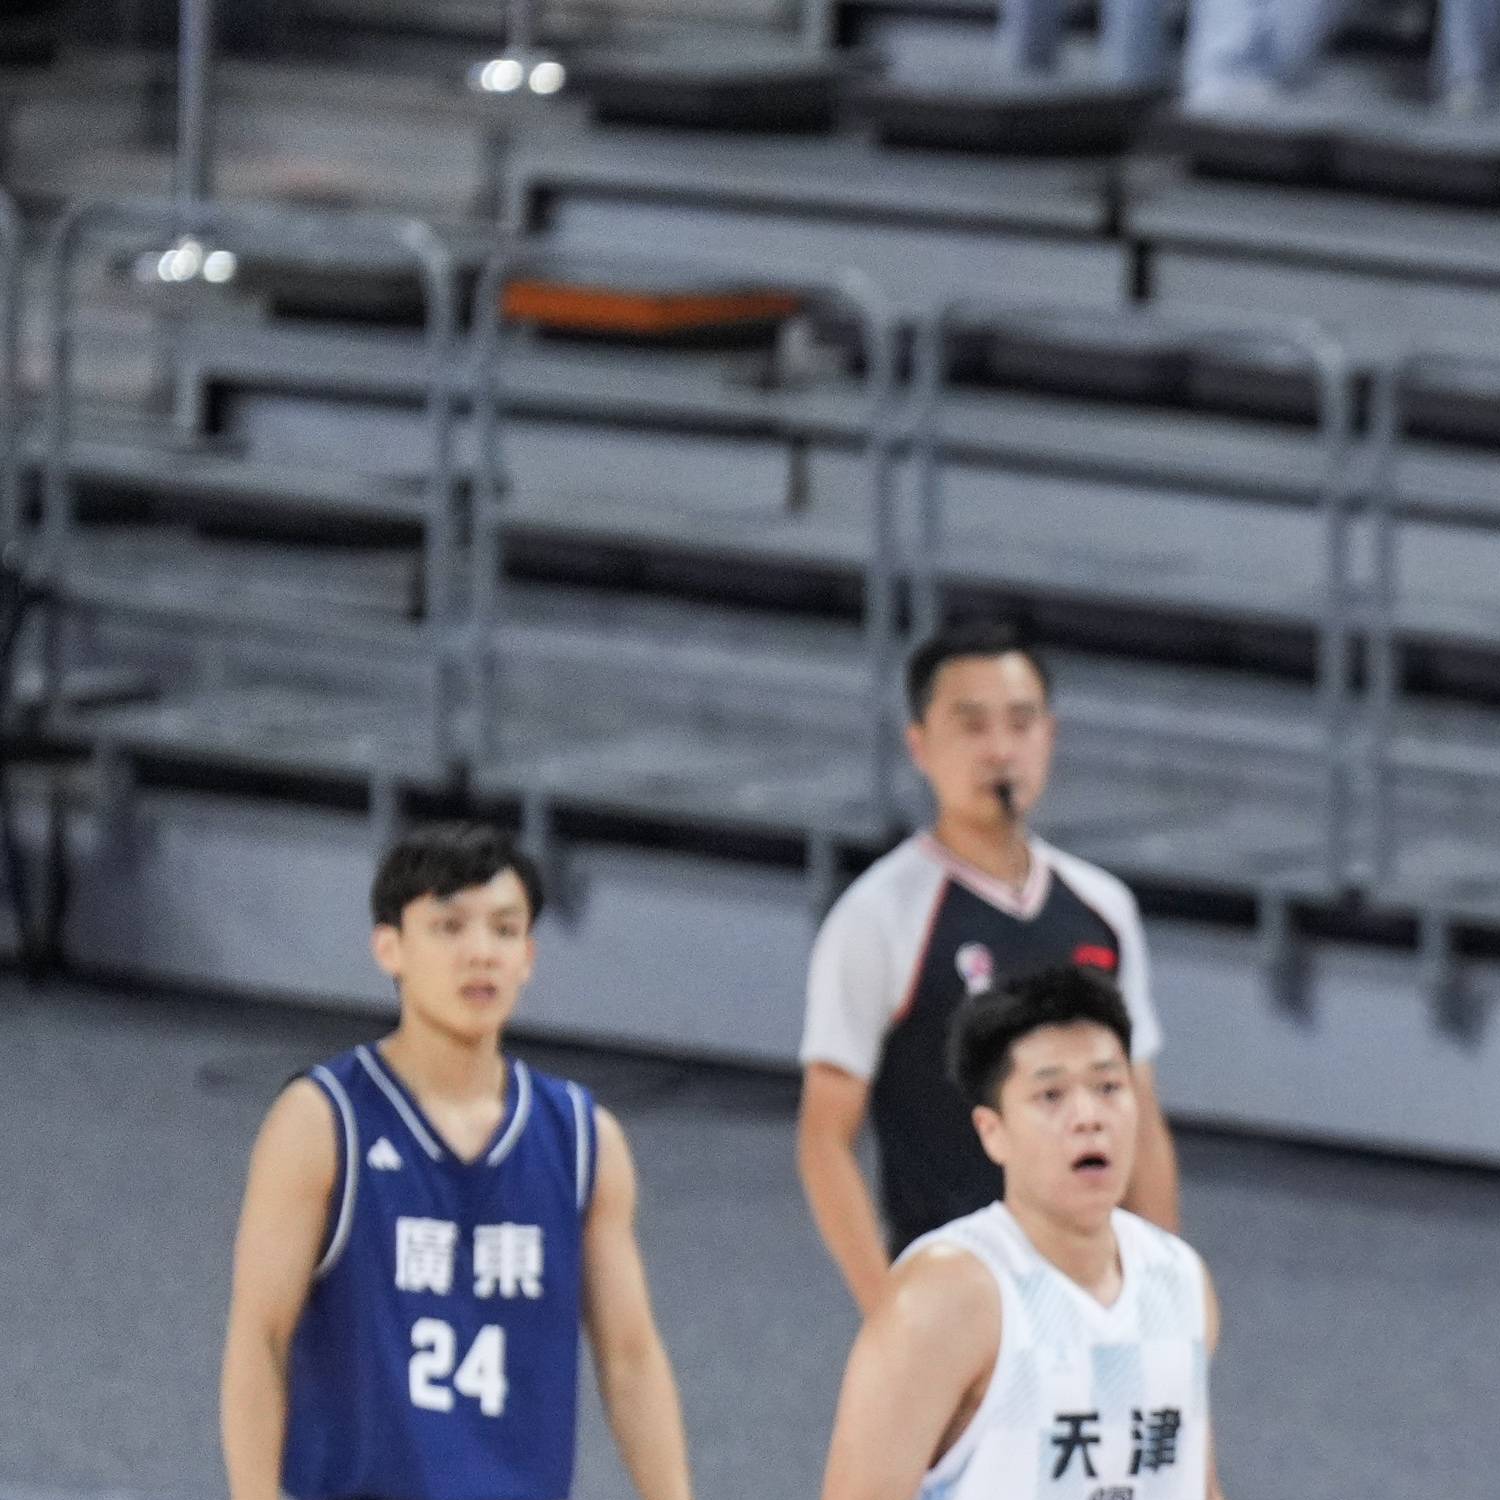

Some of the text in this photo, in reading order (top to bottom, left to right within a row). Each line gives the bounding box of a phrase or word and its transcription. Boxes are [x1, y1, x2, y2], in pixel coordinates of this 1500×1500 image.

[395, 1216, 544, 1300] 廣東
[408, 1317, 508, 1418] 24
[1050, 1408, 1183, 1481] 天津
